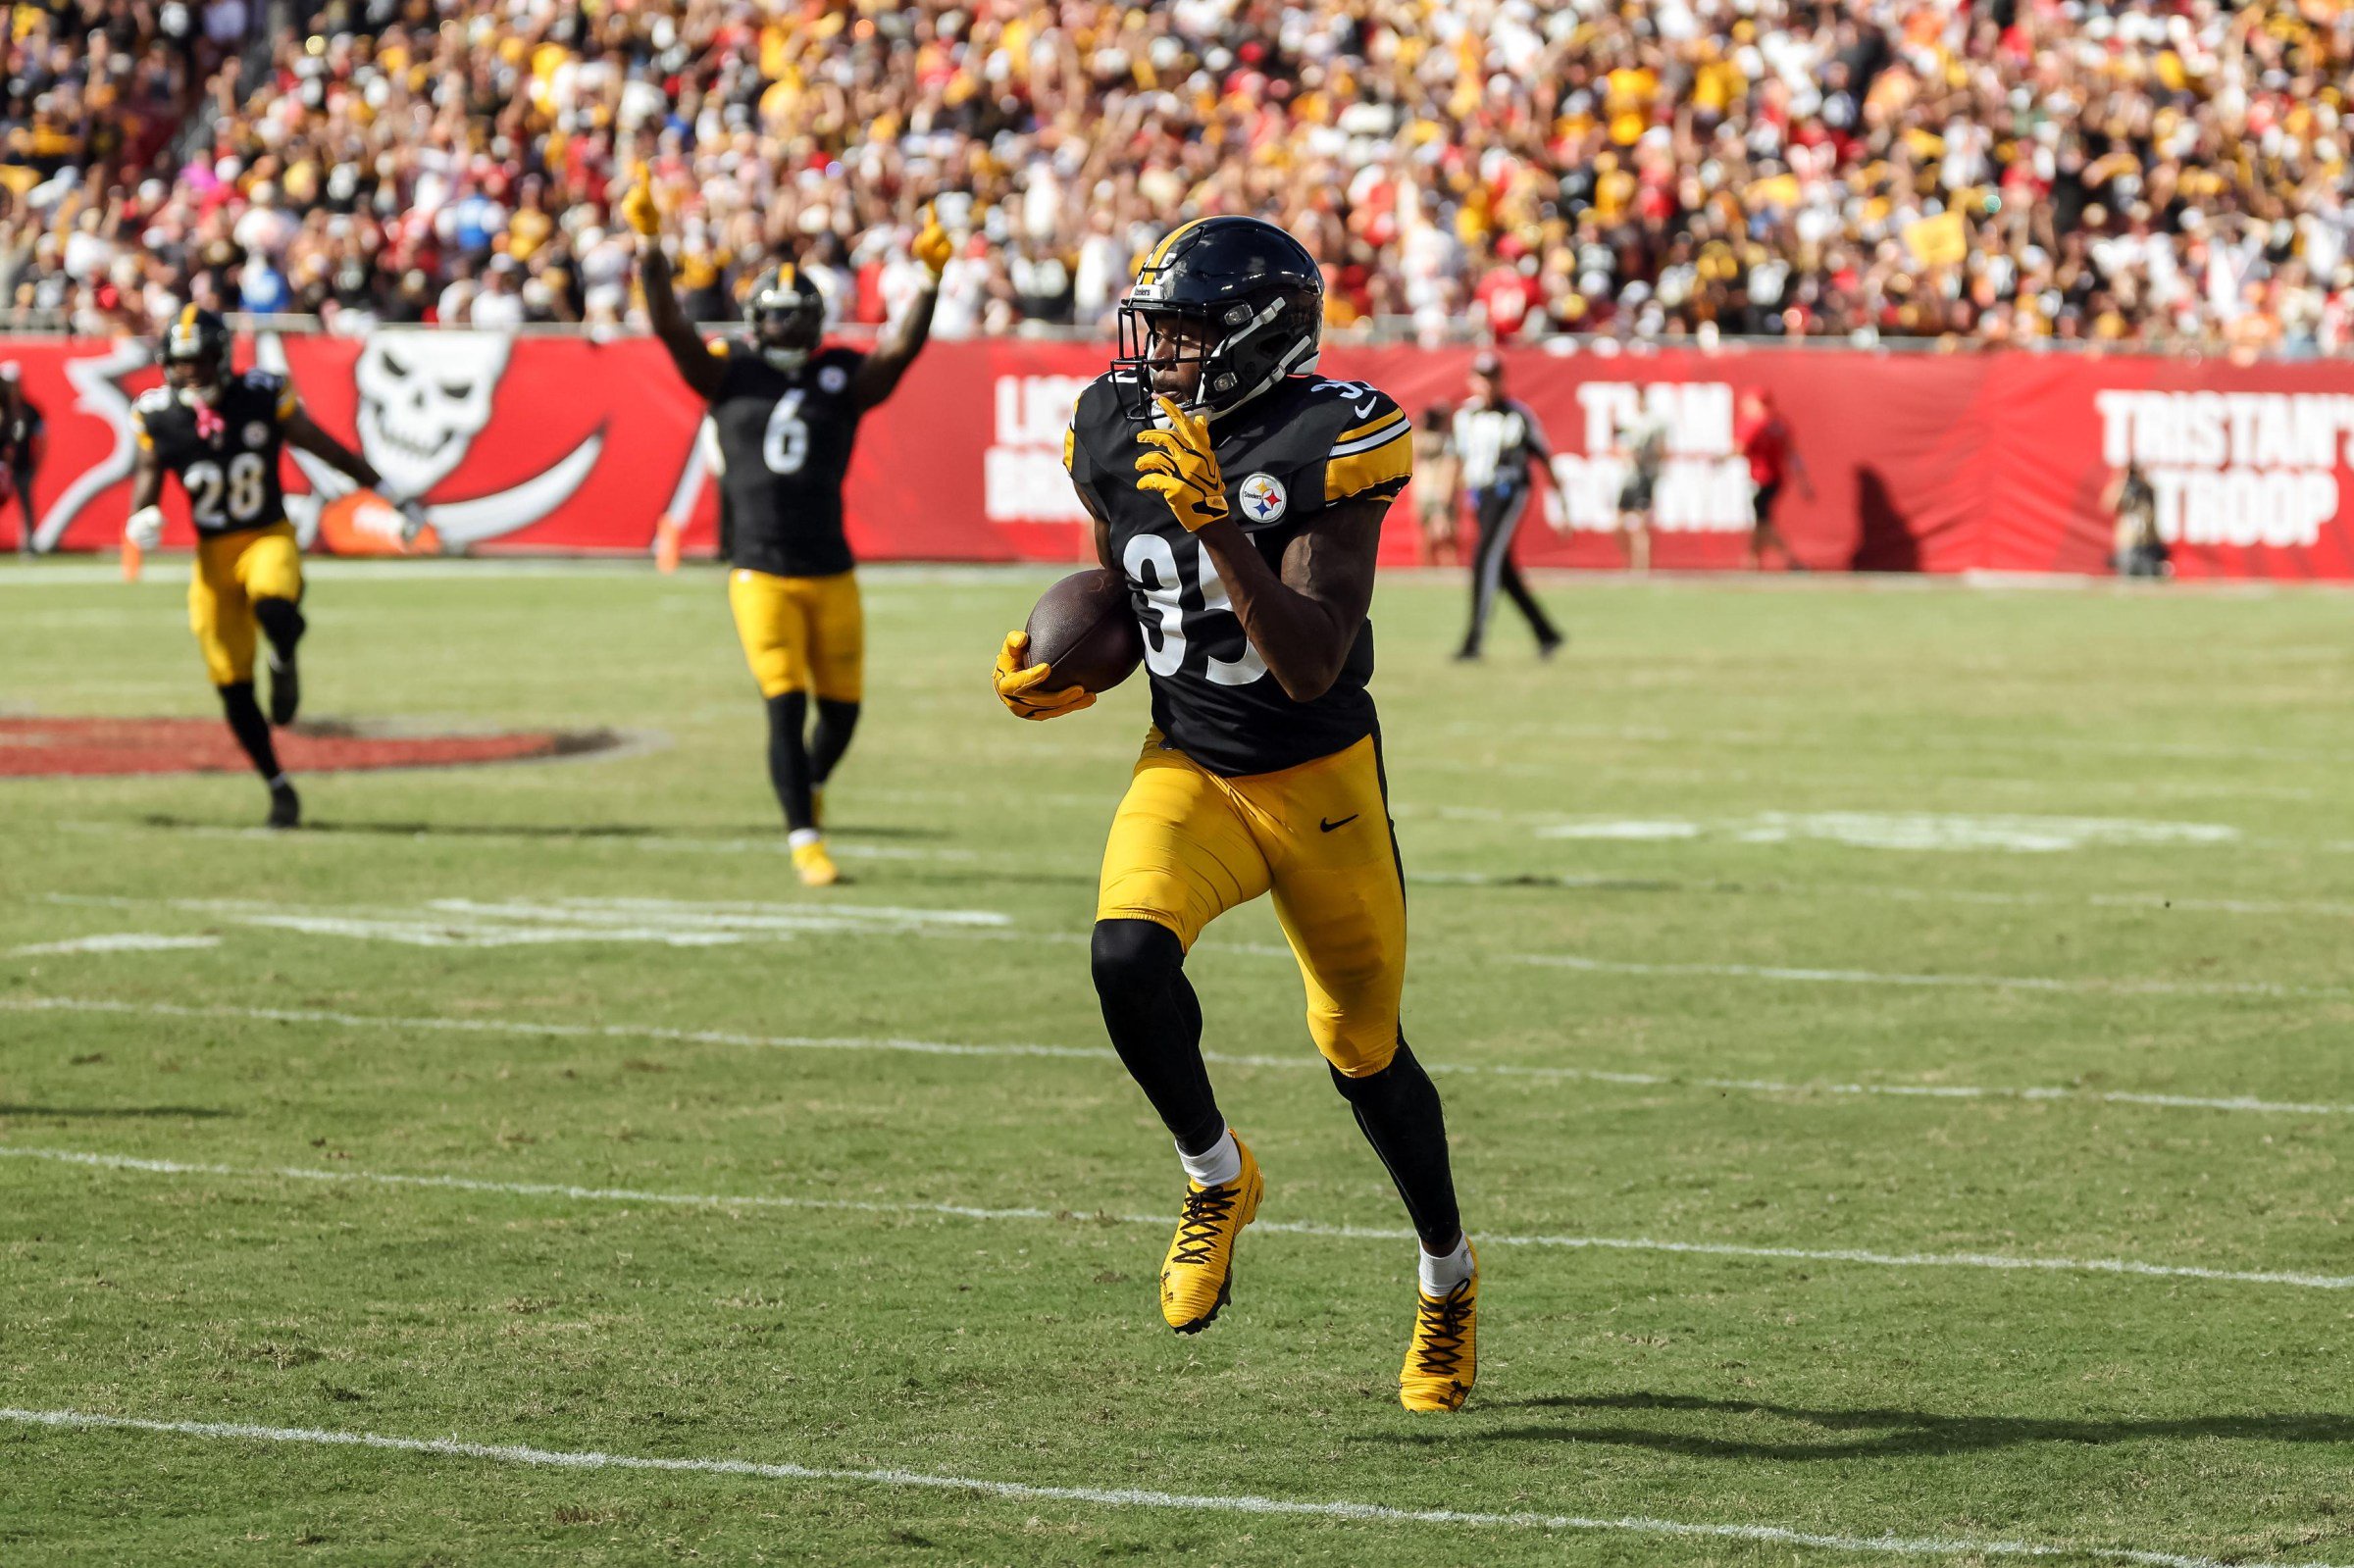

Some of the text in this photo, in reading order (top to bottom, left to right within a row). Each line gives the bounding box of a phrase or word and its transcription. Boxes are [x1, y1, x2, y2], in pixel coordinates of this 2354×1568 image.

[763, 388, 808, 475] 6
[2095, 389, 2354, 469] TRISTAN'
[185, 452, 266, 529] 28
[2151, 469, 2340, 547] TROOP
